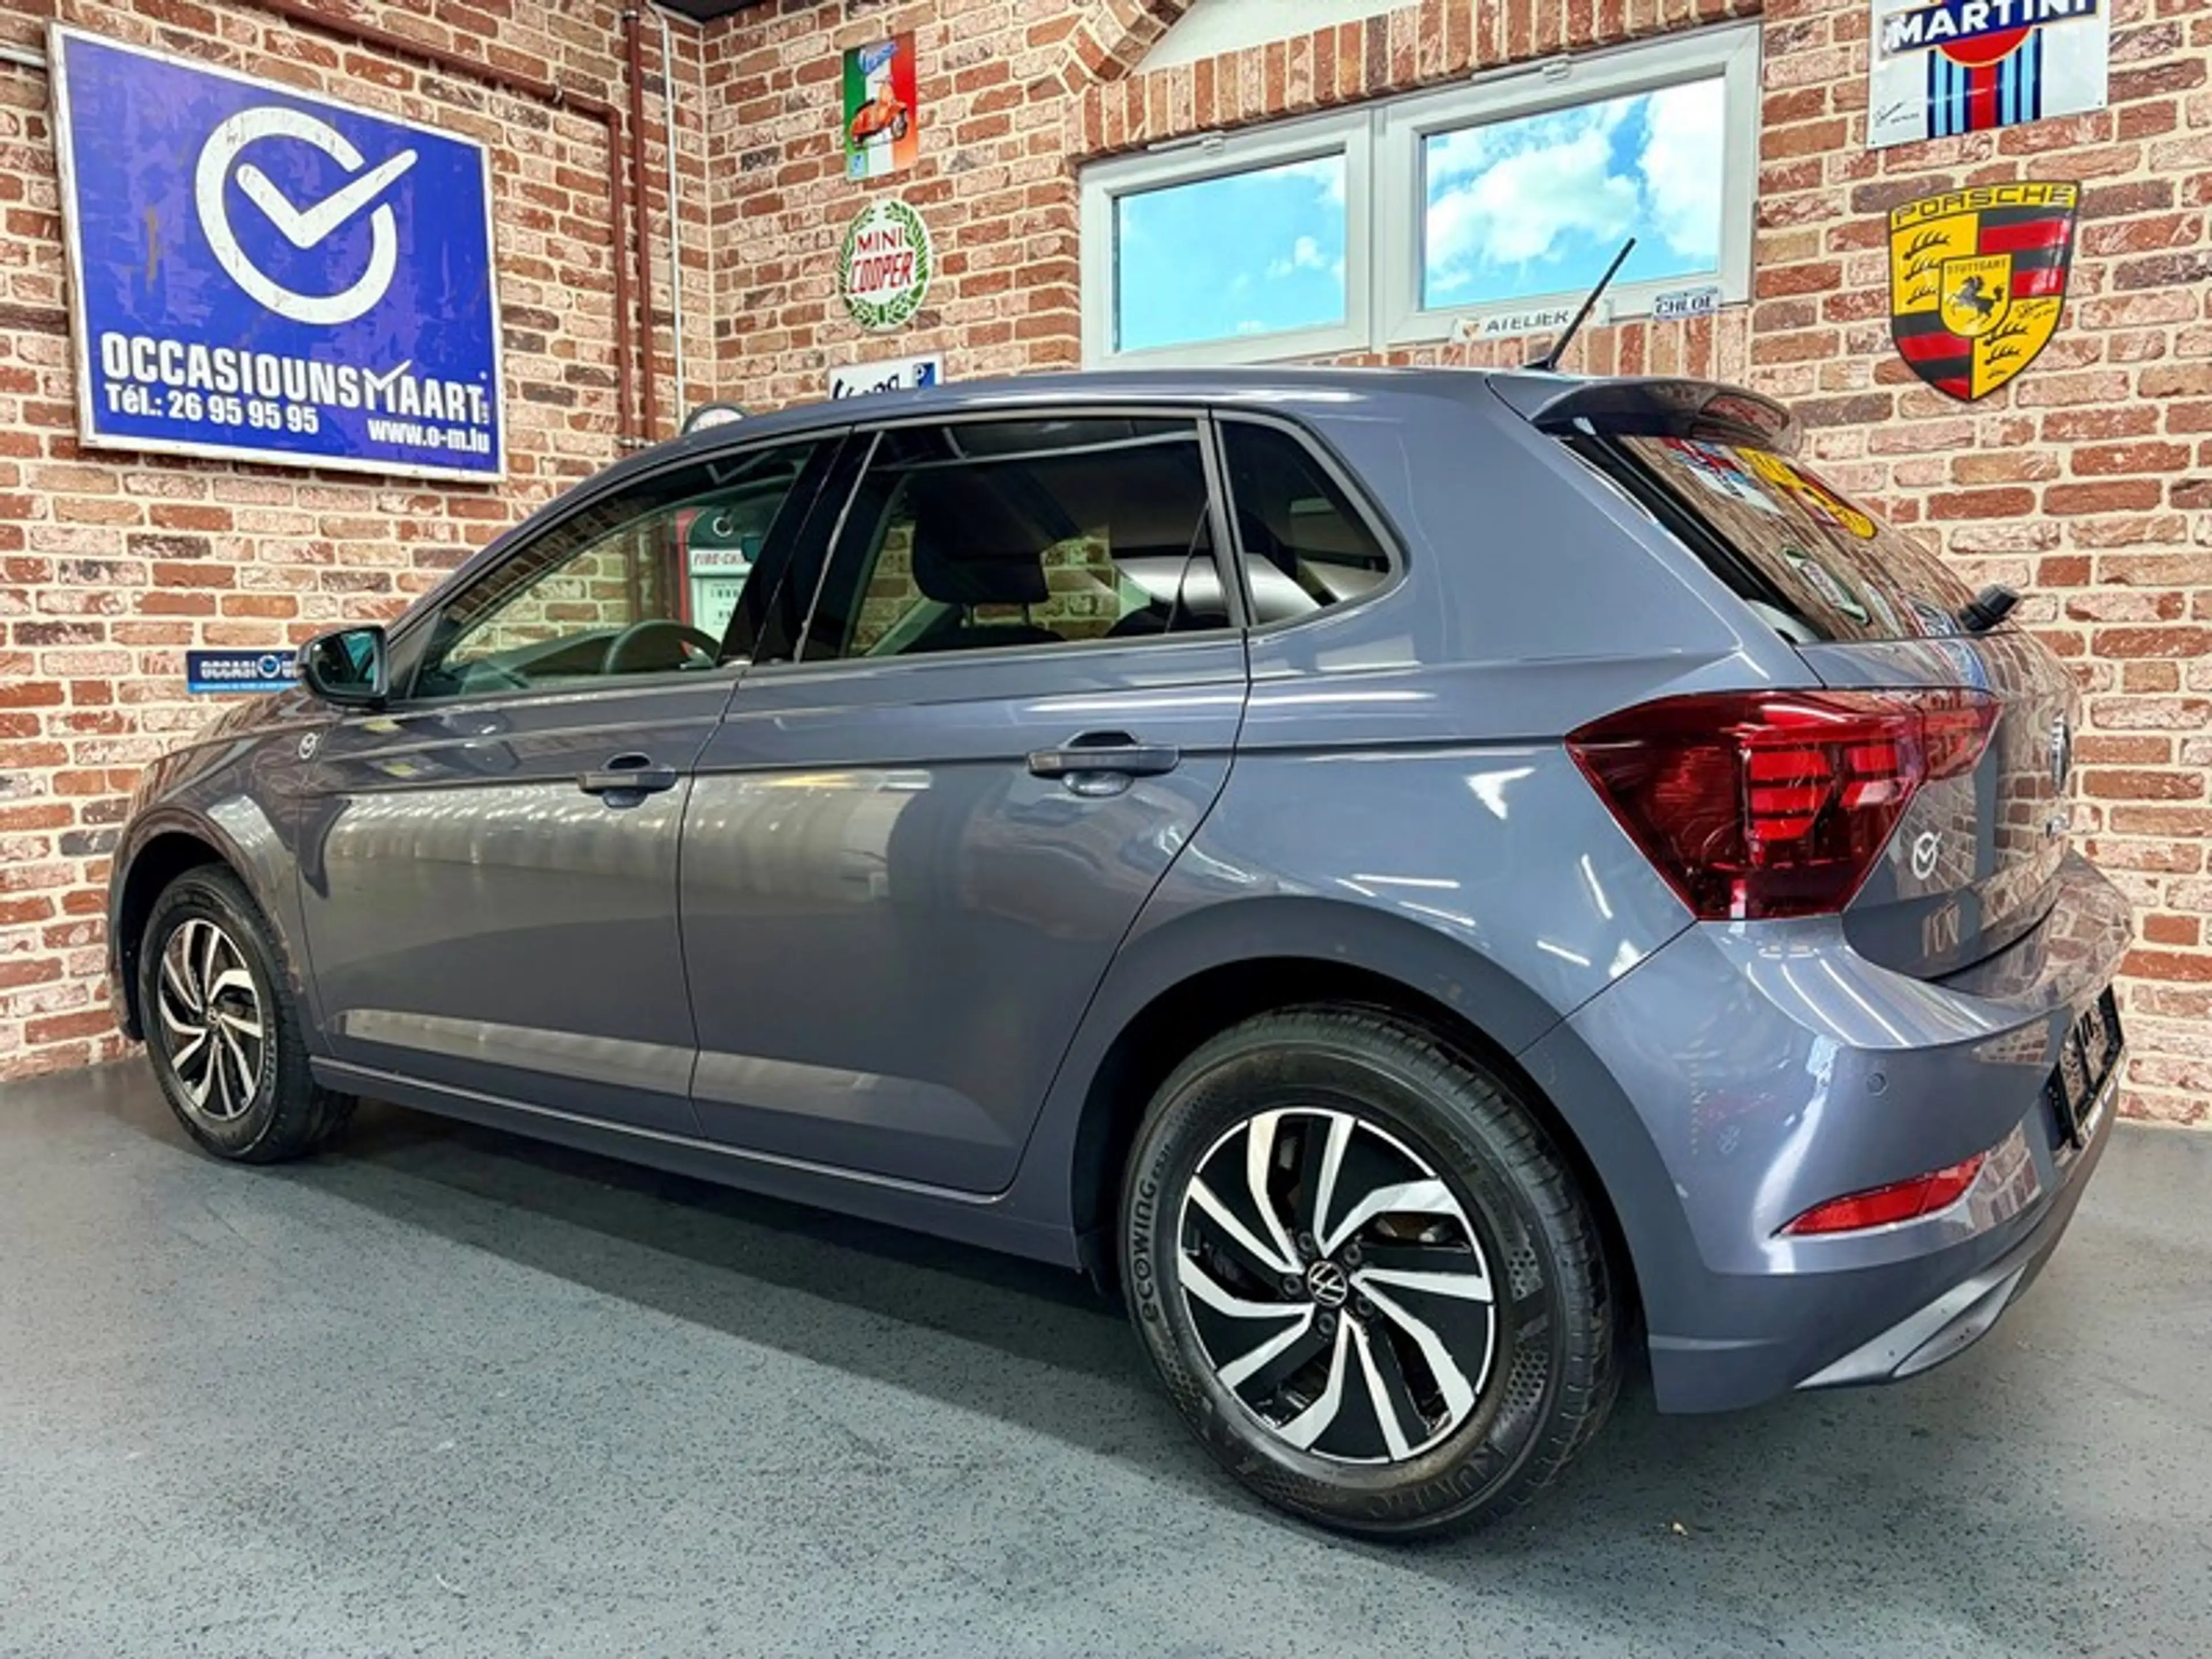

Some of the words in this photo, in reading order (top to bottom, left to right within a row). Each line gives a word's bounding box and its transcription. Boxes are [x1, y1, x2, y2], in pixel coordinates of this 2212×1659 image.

[1895, 185, 2075, 225] PORSCHE
[857, 227, 903, 254] MINI
[850, 252, 914, 294] COOPER
[1947, 258, 2007, 274] STUTTGART
[105, 382, 162, 416] Tél.:
[168, 389, 203, 421] 26
[208, 395, 243, 425] 95
[249, 400, 281, 430] 95
[286, 406, 319, 434] 95
[368, 418, 490, 453] www.o-m.lu
